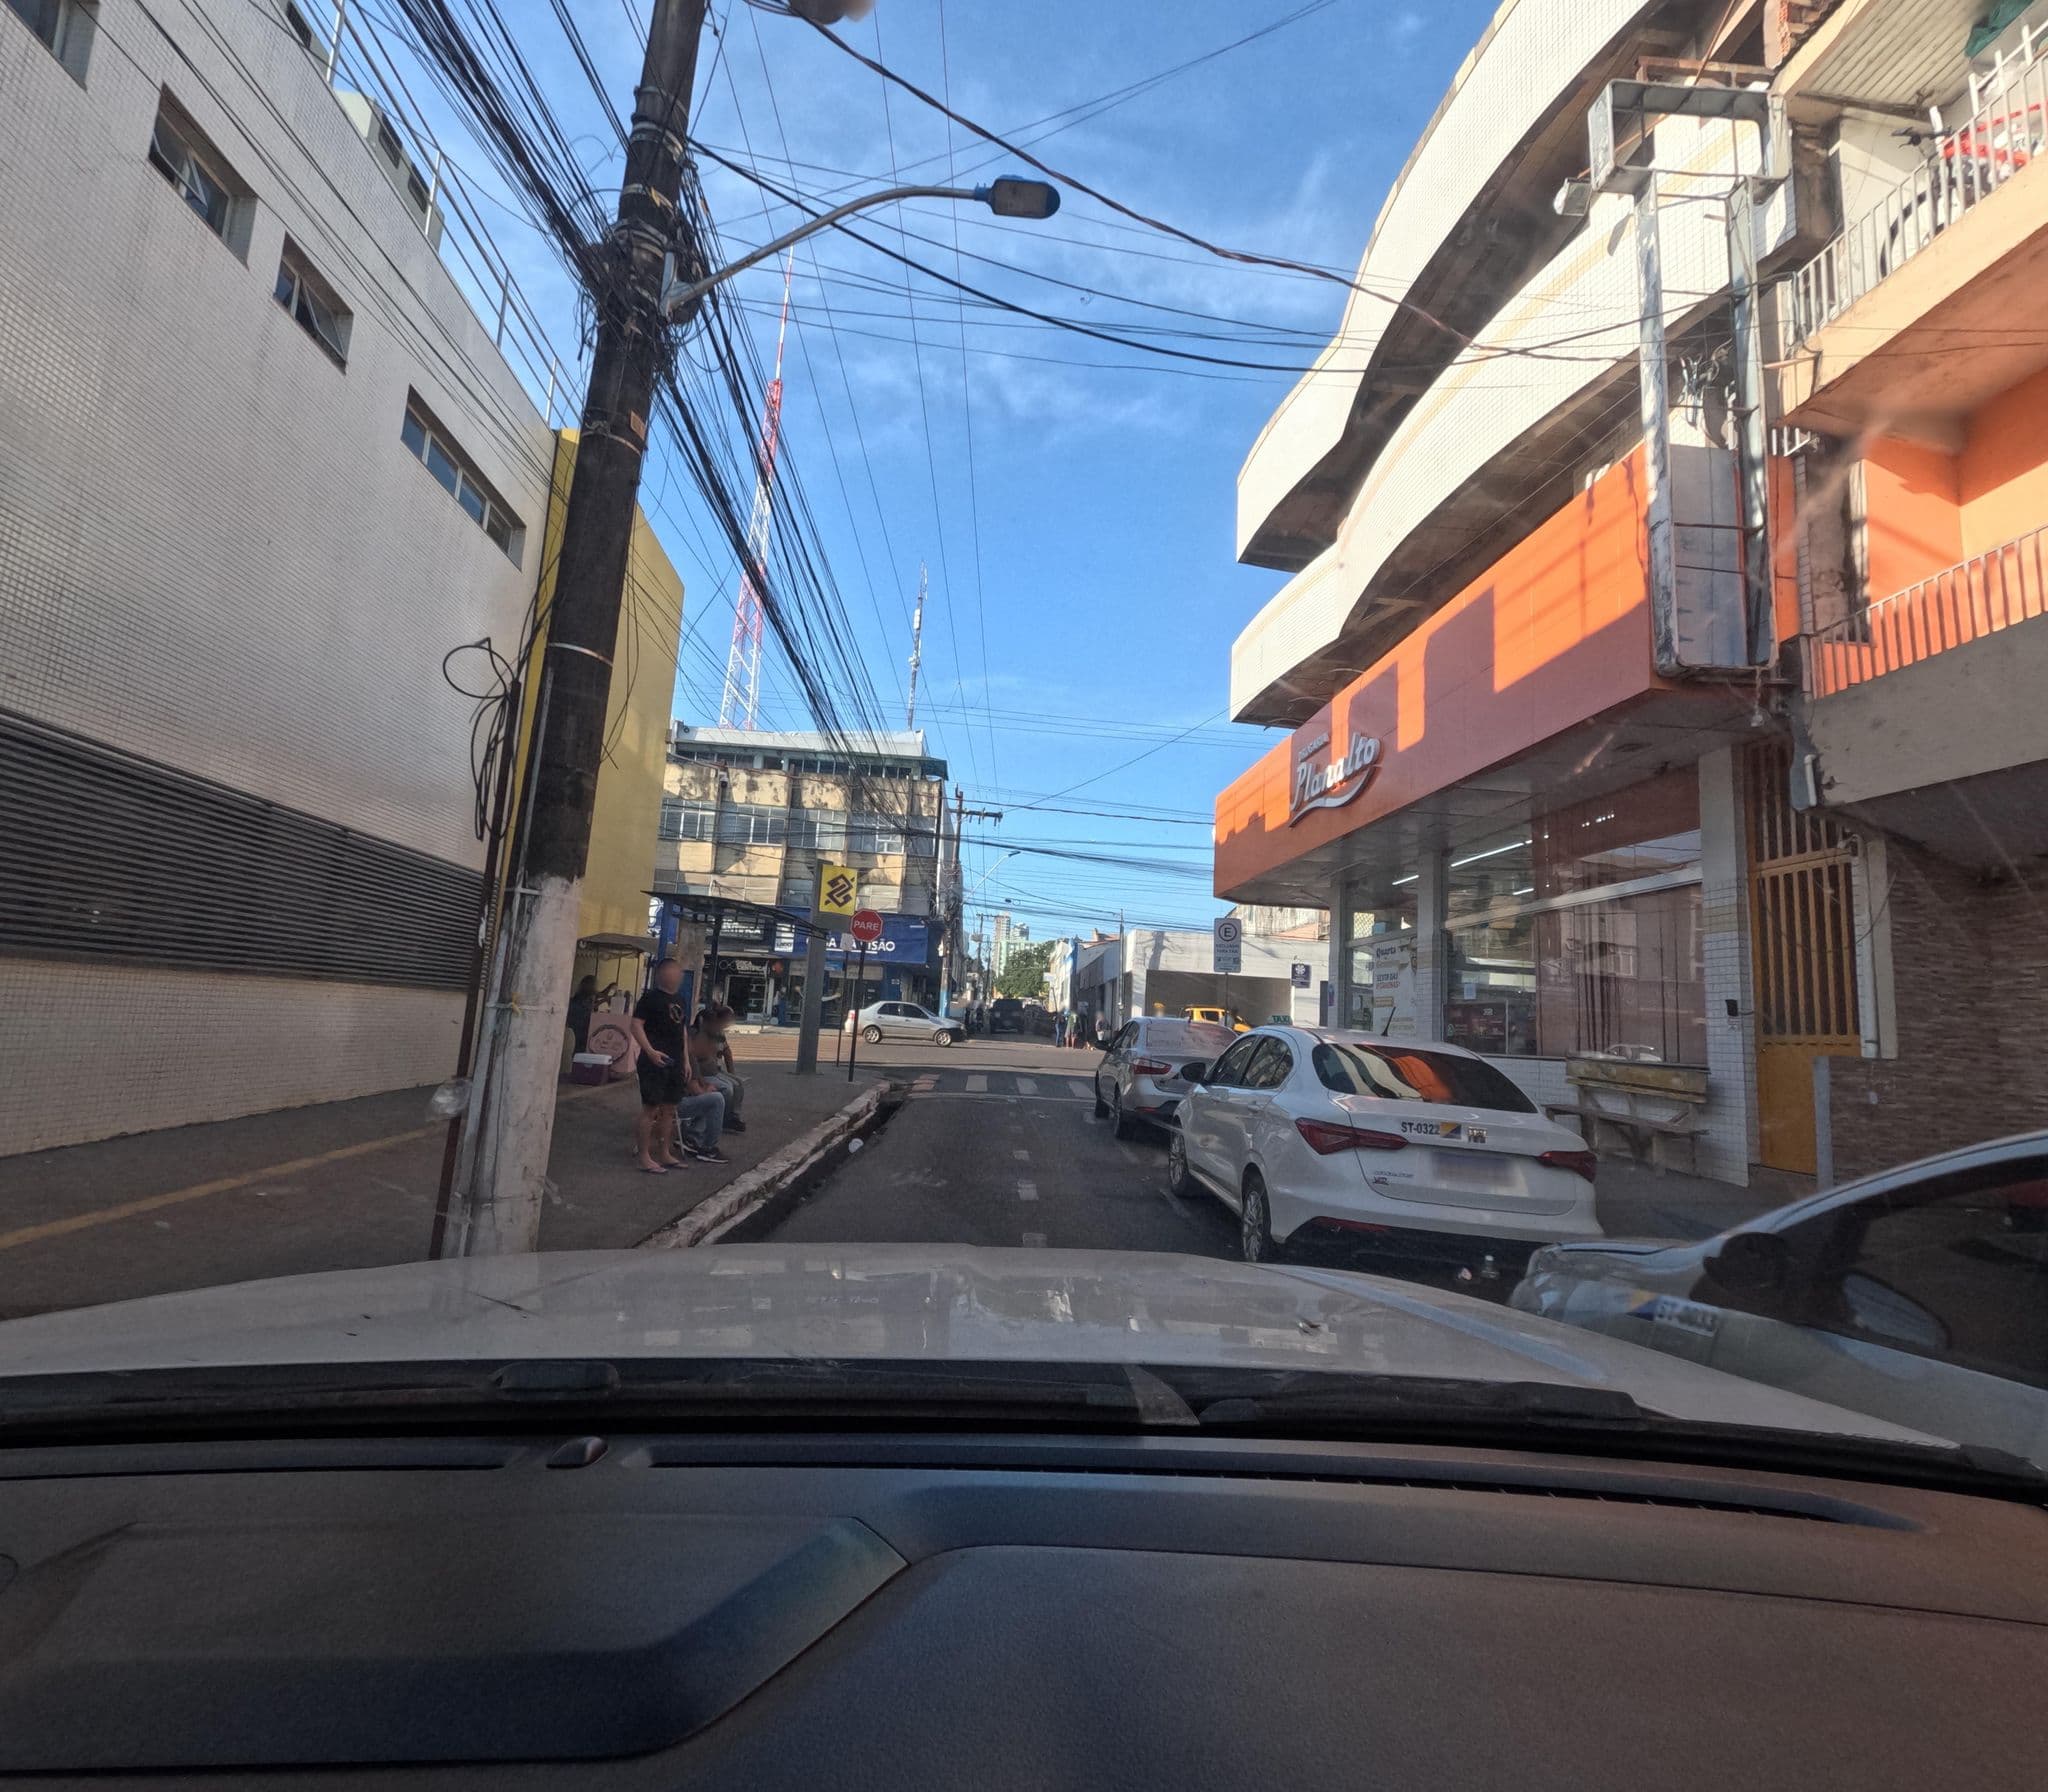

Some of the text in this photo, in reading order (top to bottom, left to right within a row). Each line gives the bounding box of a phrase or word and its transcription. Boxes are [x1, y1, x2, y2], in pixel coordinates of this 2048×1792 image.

[1291, 732, 1381, 812] Planalto
[853, 920, 879, 931] PARE
[1223, 927, 1232, 938] E
[1271, 1015, 1291, 1023] TAXI
